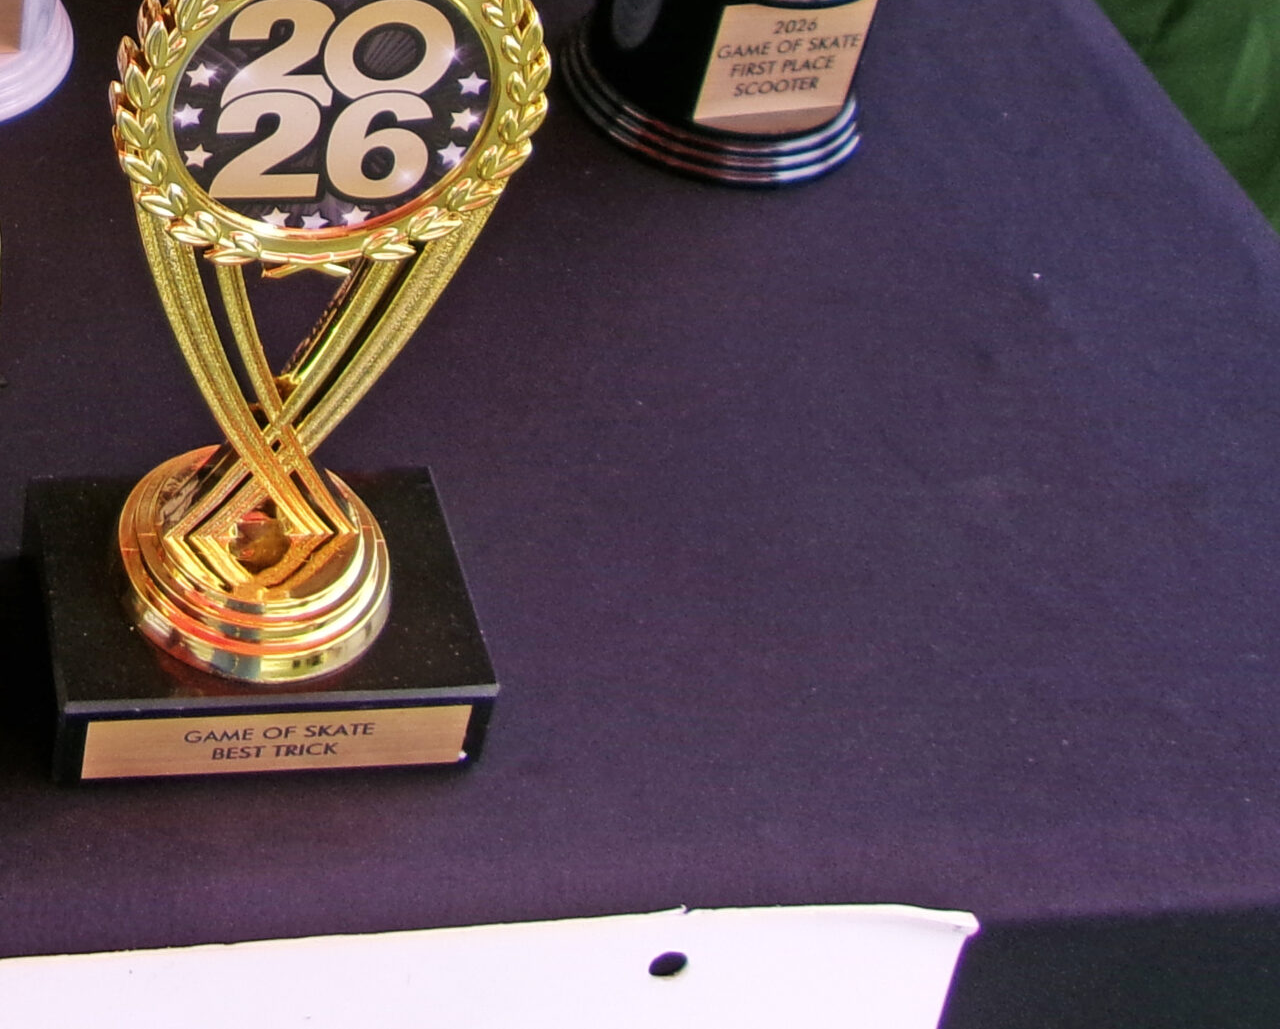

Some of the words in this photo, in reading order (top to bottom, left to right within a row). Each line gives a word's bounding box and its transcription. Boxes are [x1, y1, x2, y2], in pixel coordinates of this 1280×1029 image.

[774, 18, 818, 34] 2026
[717, 41, 771, 59] GAME
[776, 38, 804, 54] OF
[807, 33, 861, 51] SKATE
[730, 60, 777, 78] FIRST
[781, 54, 836, 73] PLACE
[733, 76, 819, 97] SCOOTER
[183, 728, 254, 744] GAME
[262, 725, 297, 741] OF
[303, 722, 377, 738] SKATE
[211, 744, 266, 761] BEST
[272, 741, 339, 758] TRICK
